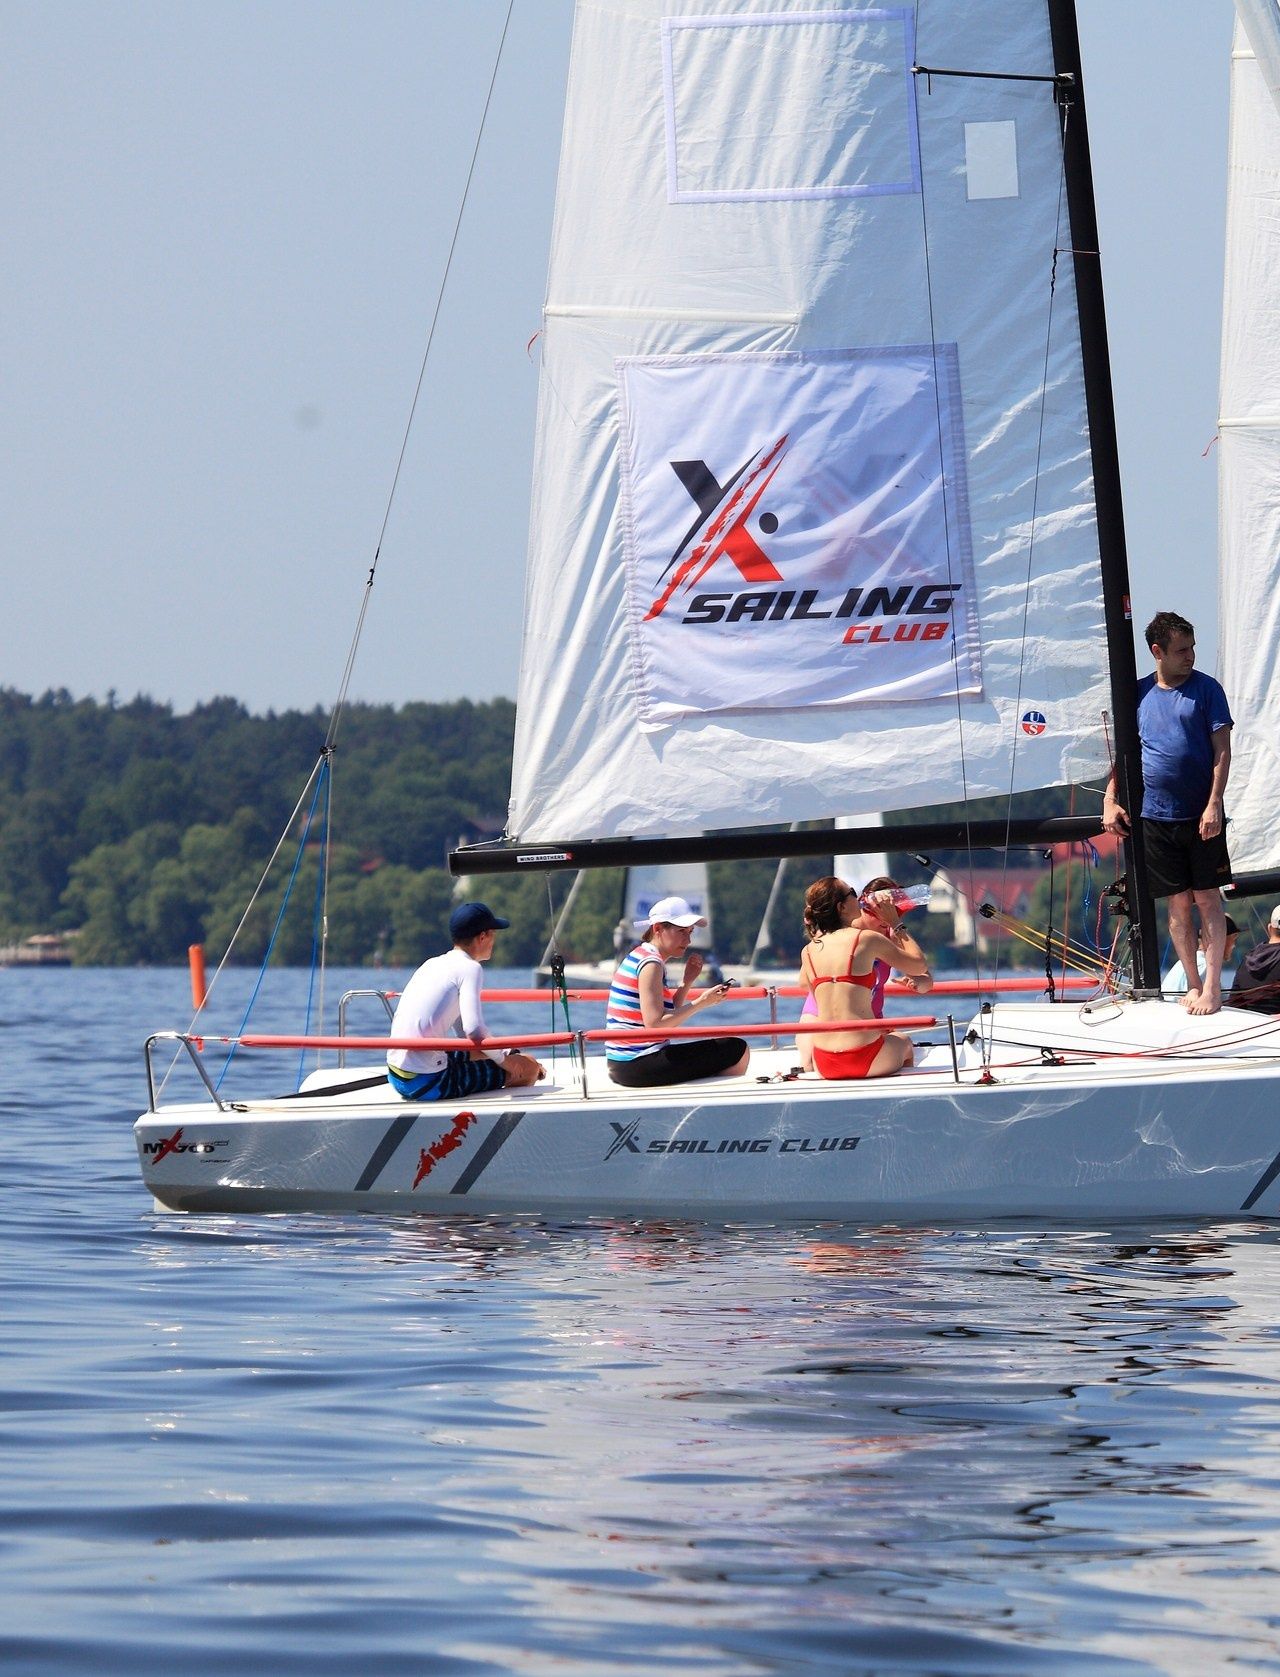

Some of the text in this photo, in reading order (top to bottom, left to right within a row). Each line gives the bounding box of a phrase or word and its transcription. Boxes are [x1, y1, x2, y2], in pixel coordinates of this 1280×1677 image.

[682, 583, 962, 624] SAILING
[842, 622, 949, 644] CLUB
[646, 1139, 772, 1153] SAILING
[779, 1137, 861, 1152] CLUB
